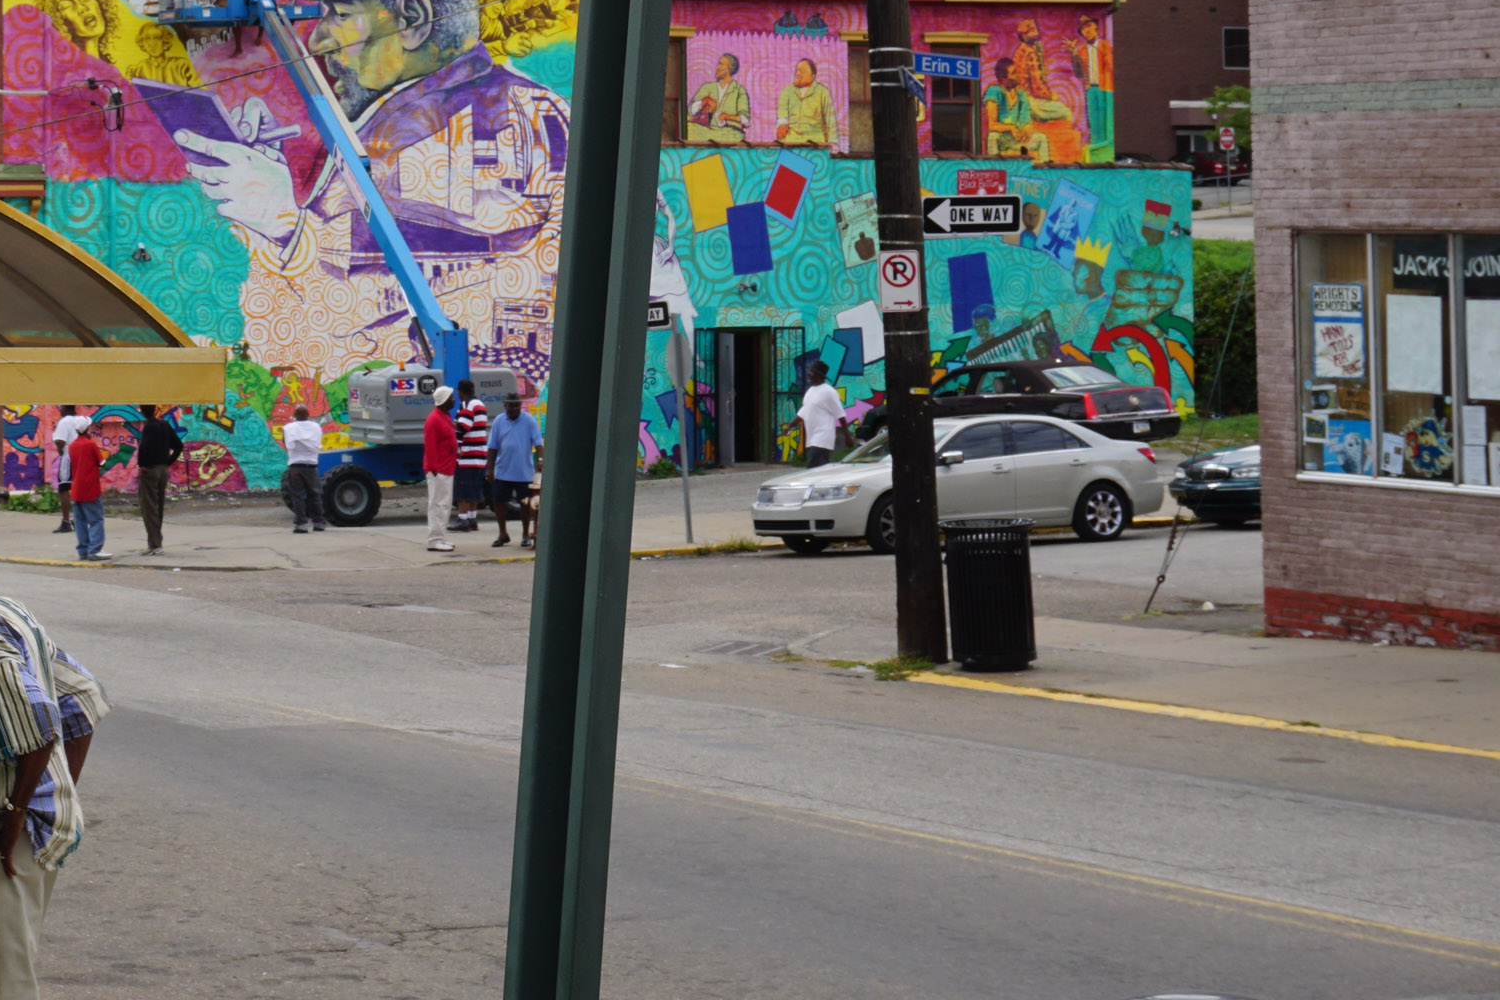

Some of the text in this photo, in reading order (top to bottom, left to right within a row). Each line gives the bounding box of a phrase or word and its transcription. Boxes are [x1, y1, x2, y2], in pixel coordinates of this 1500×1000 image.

[922, 57, 973, 76] Erin St
[1010, 180, 1050, 199] JITNEY
[950, 207, 1009, 223] ONE WAY
[650, 309, 660, 320] AY
[390, 378, 415, 390] NES
